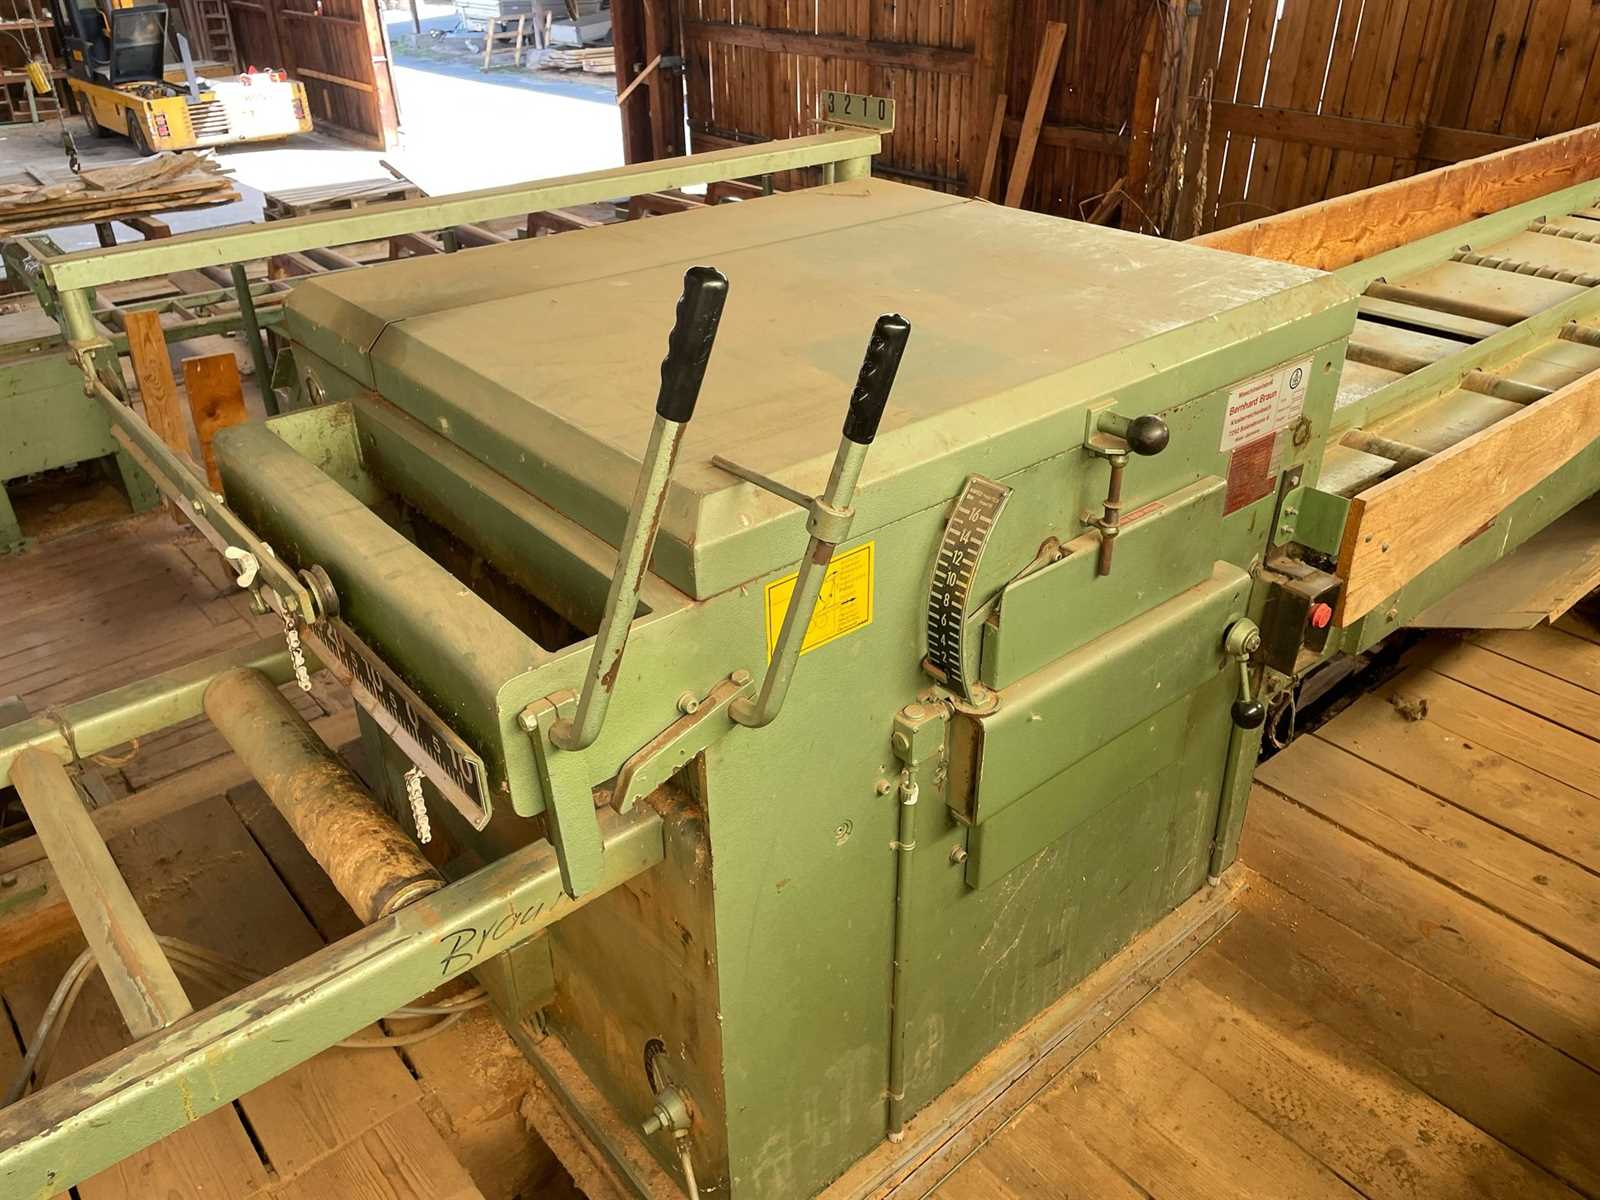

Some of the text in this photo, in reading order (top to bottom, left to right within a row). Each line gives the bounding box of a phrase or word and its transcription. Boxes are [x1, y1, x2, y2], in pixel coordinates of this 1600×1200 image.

[828, 92, 885, 120] 3 2 1 0
[968, 507, 981, 522] 16
[959, 528, 972, 544] 14
[952, 550, 964, 566] 12
[946, 571, 957, 587] 10
[943, 593, 950, 607] 8
[941, 614, 947, 626] 6
[940, 634, 946, 646] 4
[941, 651, 947, 662] 2
[389, 691, 397, 709] 5
[432, 735, 440, 754] 5
[446, 743, 473, 784] 10
